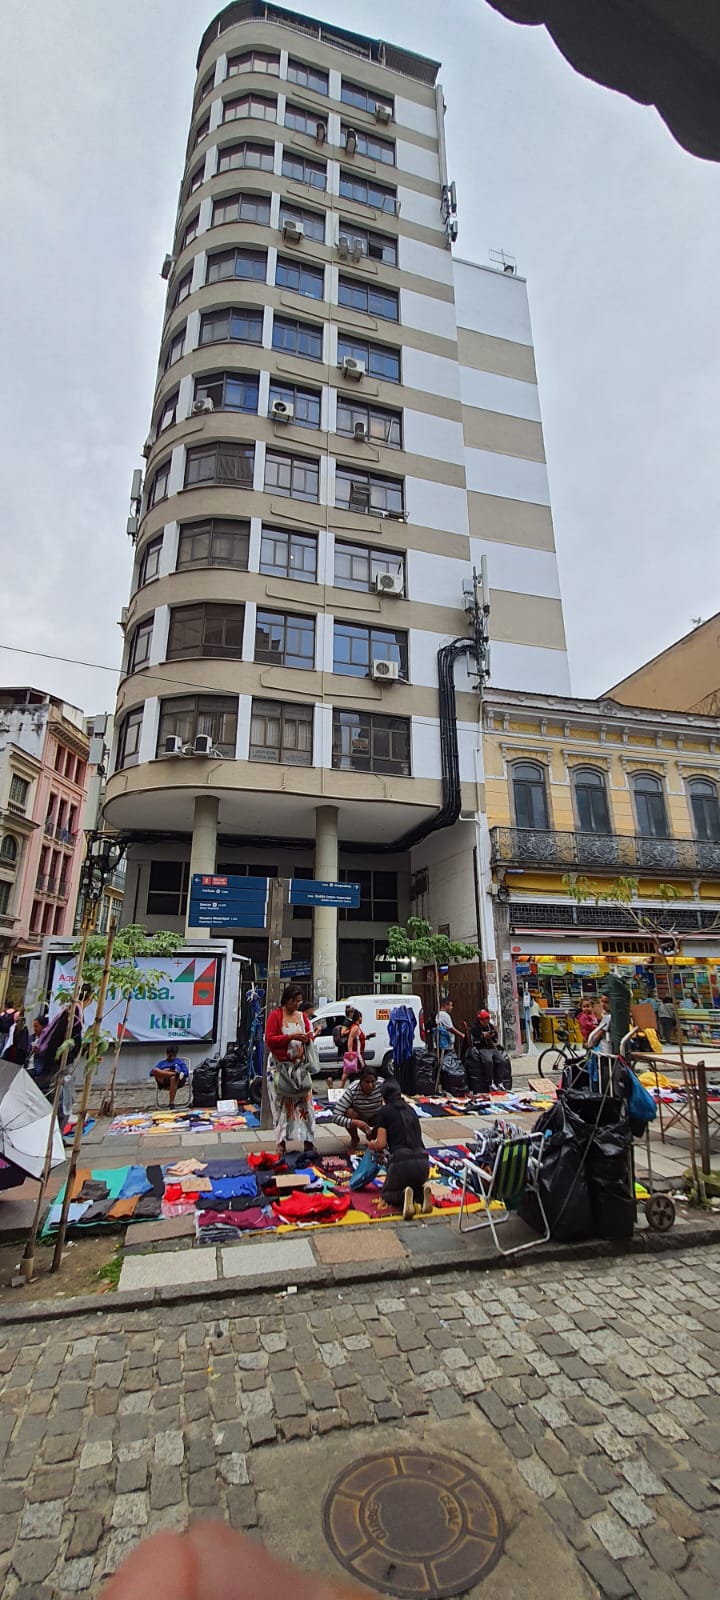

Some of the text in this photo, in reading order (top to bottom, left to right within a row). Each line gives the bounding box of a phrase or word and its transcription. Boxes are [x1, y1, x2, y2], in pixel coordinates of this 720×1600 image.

[602, 942, 656, 953] DROGARIA
[59, 974, 77, 983] Aqu
[150, 1014, 191, 1029] klini
